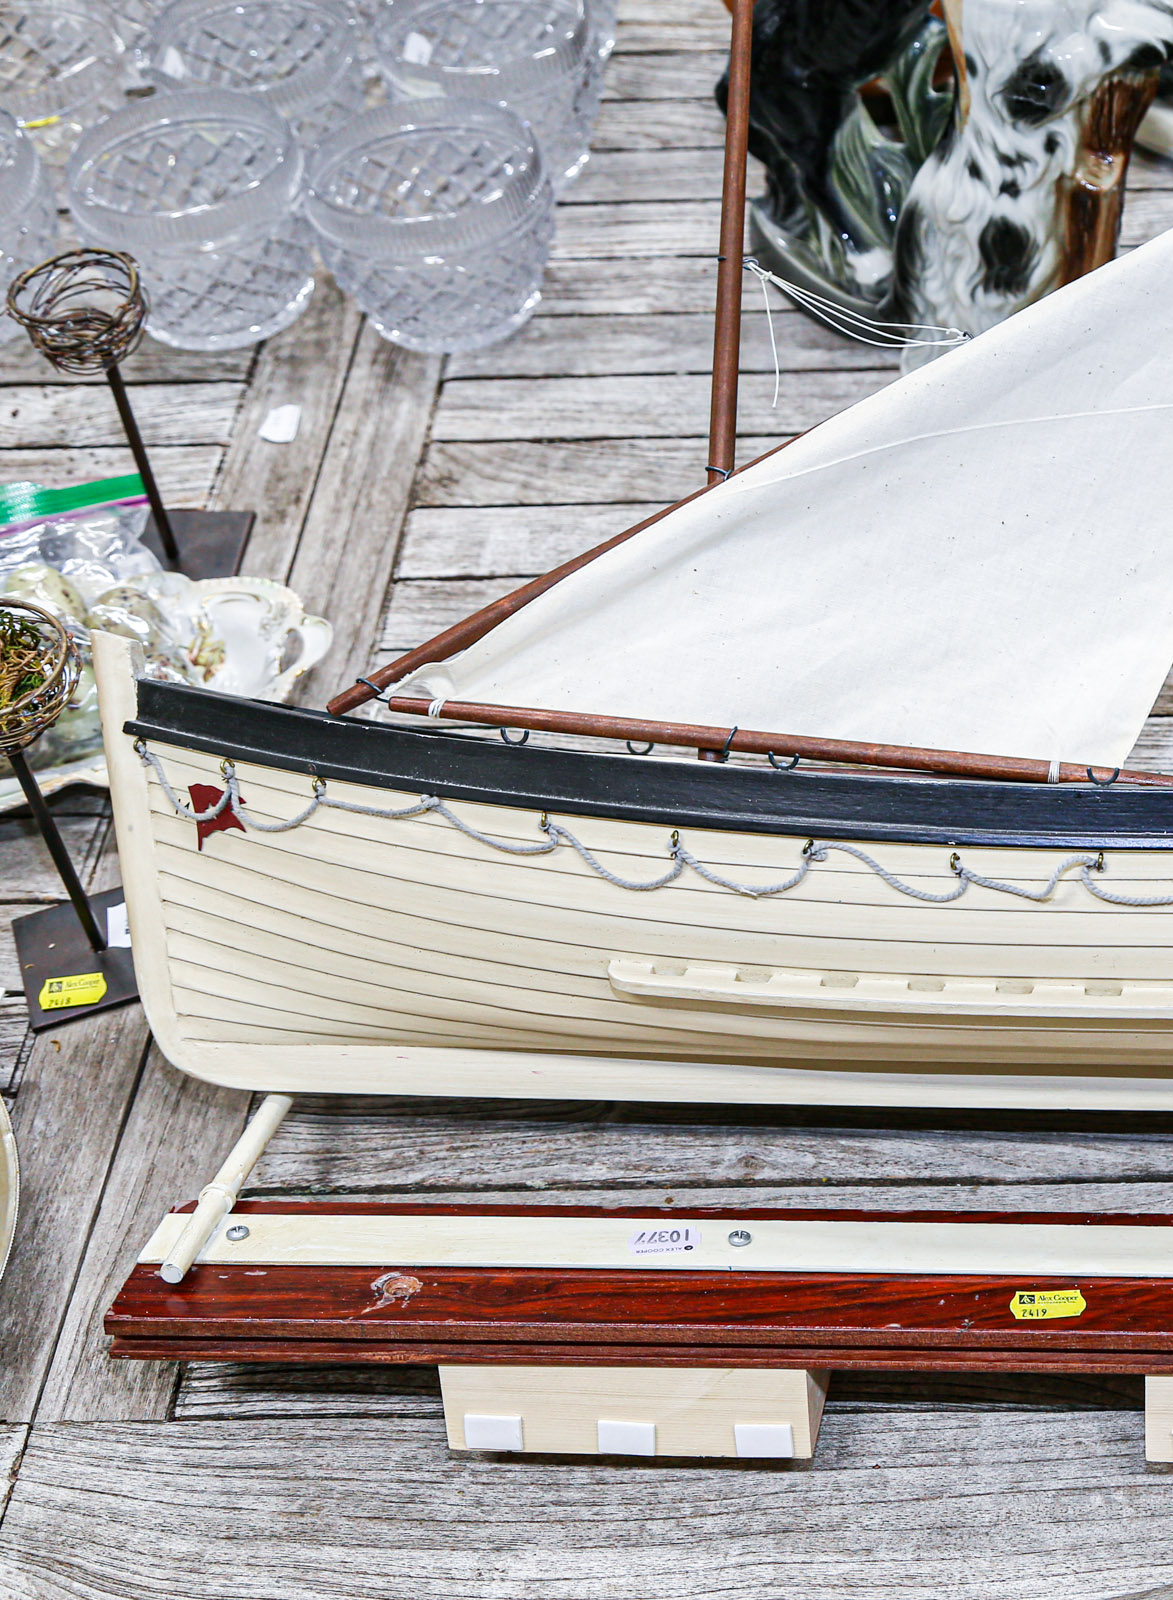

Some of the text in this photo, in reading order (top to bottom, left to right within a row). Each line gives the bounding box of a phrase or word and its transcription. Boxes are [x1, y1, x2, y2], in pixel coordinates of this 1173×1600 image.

[634, 1229, 689, 1245] 10377
[1053, 1294, 1078, 1303] Cooper
[1022, 1308, 1047, 1317] 2419
